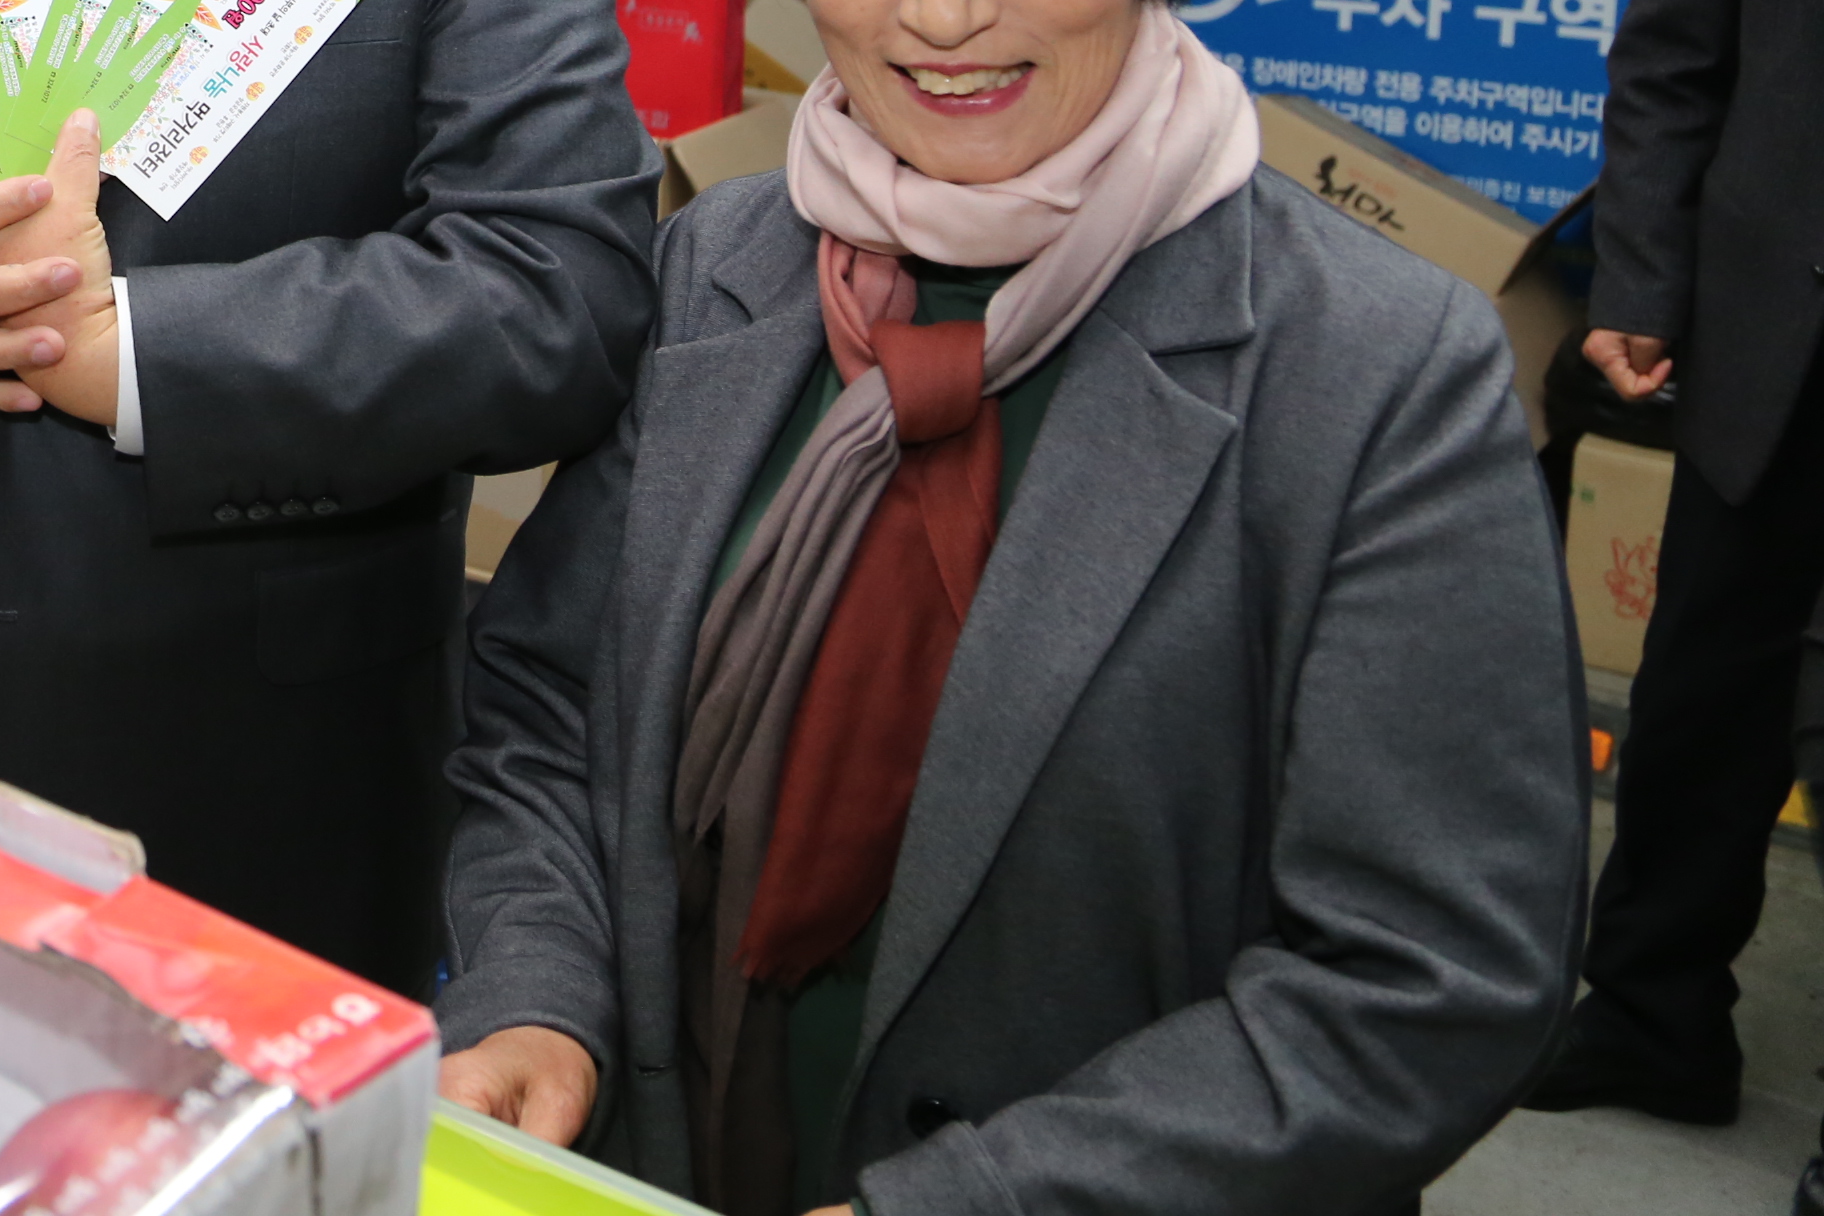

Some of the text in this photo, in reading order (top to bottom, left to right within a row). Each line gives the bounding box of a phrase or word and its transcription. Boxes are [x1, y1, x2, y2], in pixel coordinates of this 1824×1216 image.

[259, 18, 276, 36] 초대
[270, 11, 282, 22] 날
[200, 30, 267, 104] 사랑나눔
[40, 77, 54, 103] 324-1072
[108, 87, 130, 111] 324-1072
[1251, 56, 1368, 94] 장애인차량
[1373, 68, 1422, 102] 전용
[1429, 75, 1606, 122] 주차구역입니다
[132, 92, 211, 180] 먹거리장터
[1414, 112, 1514, 150] 이용하여
[1520, 122, 1599, 160] 주시기
